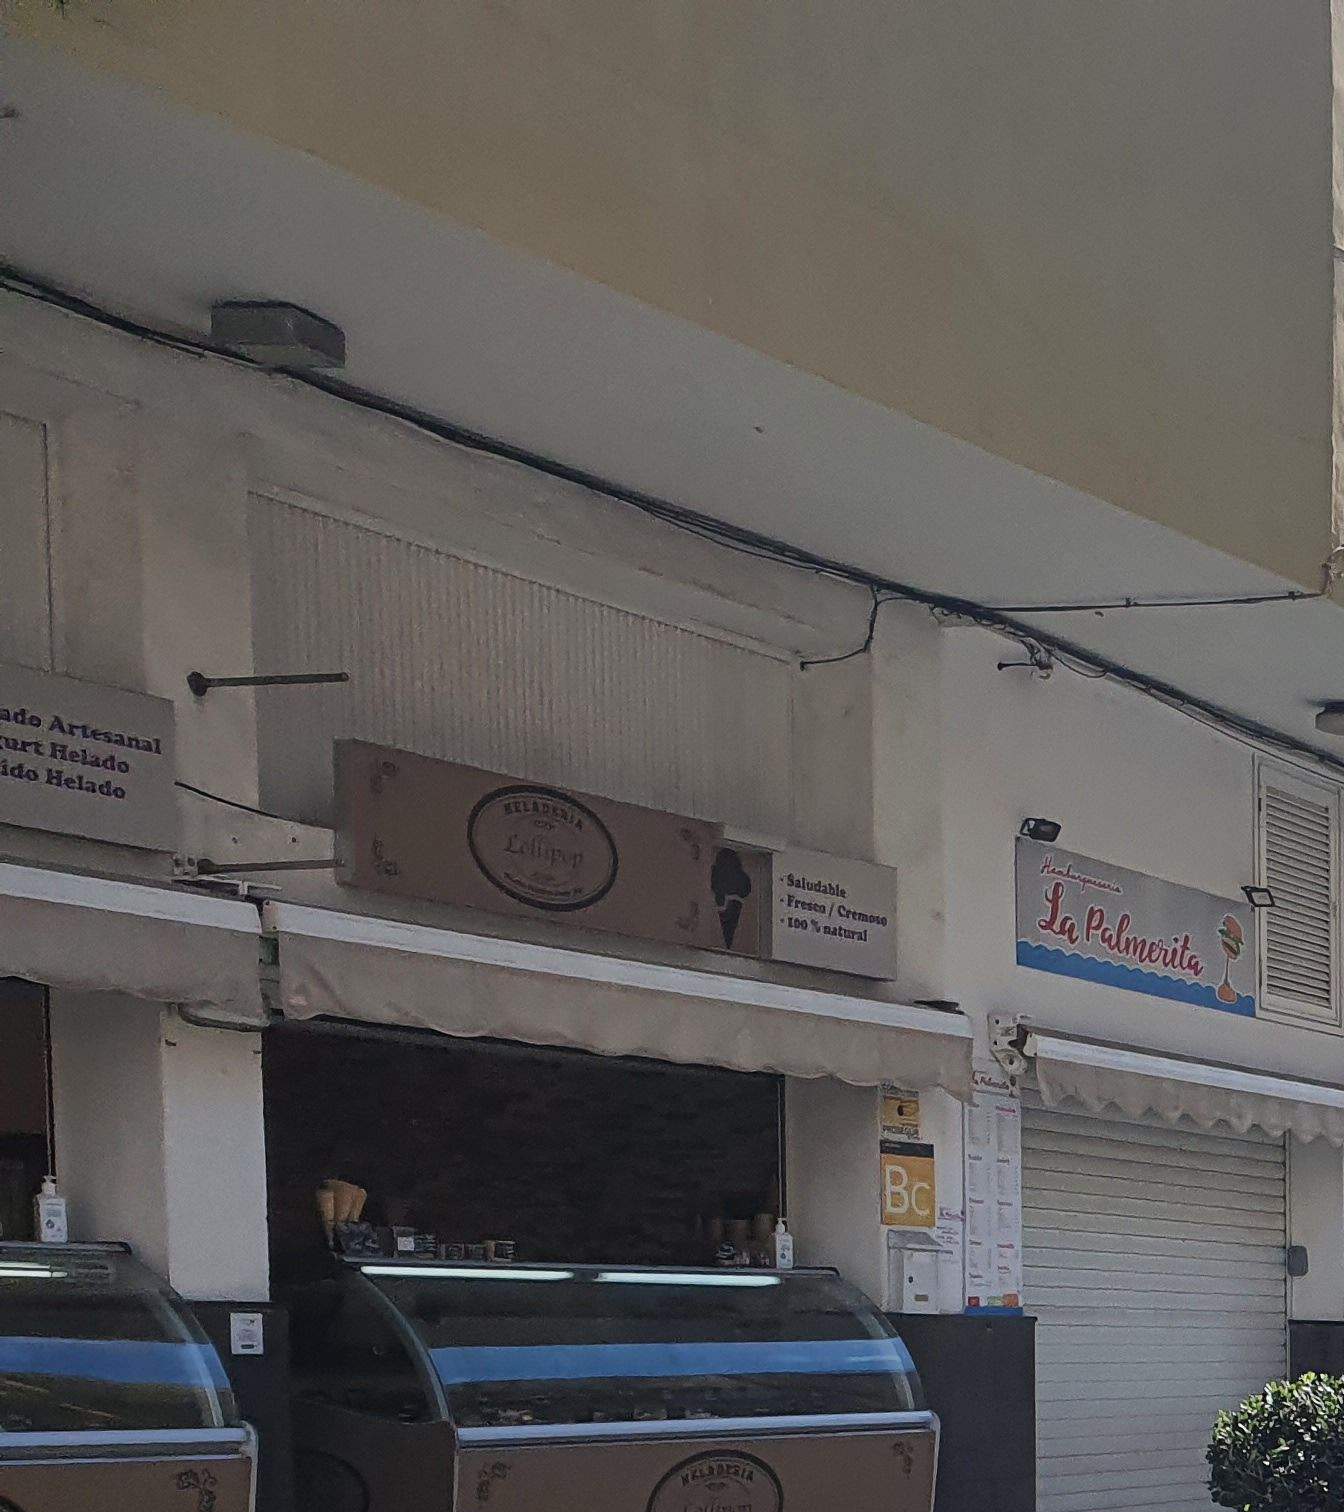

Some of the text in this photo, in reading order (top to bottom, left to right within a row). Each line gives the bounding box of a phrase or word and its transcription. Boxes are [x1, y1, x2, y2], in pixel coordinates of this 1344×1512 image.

[50, 715, 161, 754] Artesanal
[0, 734, 129, 773] urt Helado
[46, 768, 125, 799] Helado
[787, 873, 847, 898] Saludable
[787, 895, 826, 914] Fresco
[837, 905, 888, 927] Cremoso
[788, 917, 808, 931] 100
[823, 926, 868, 942] natural
[1038, 881, 1204, 977] La Palmerita
[886, 1165, 931, 1217] Bc
